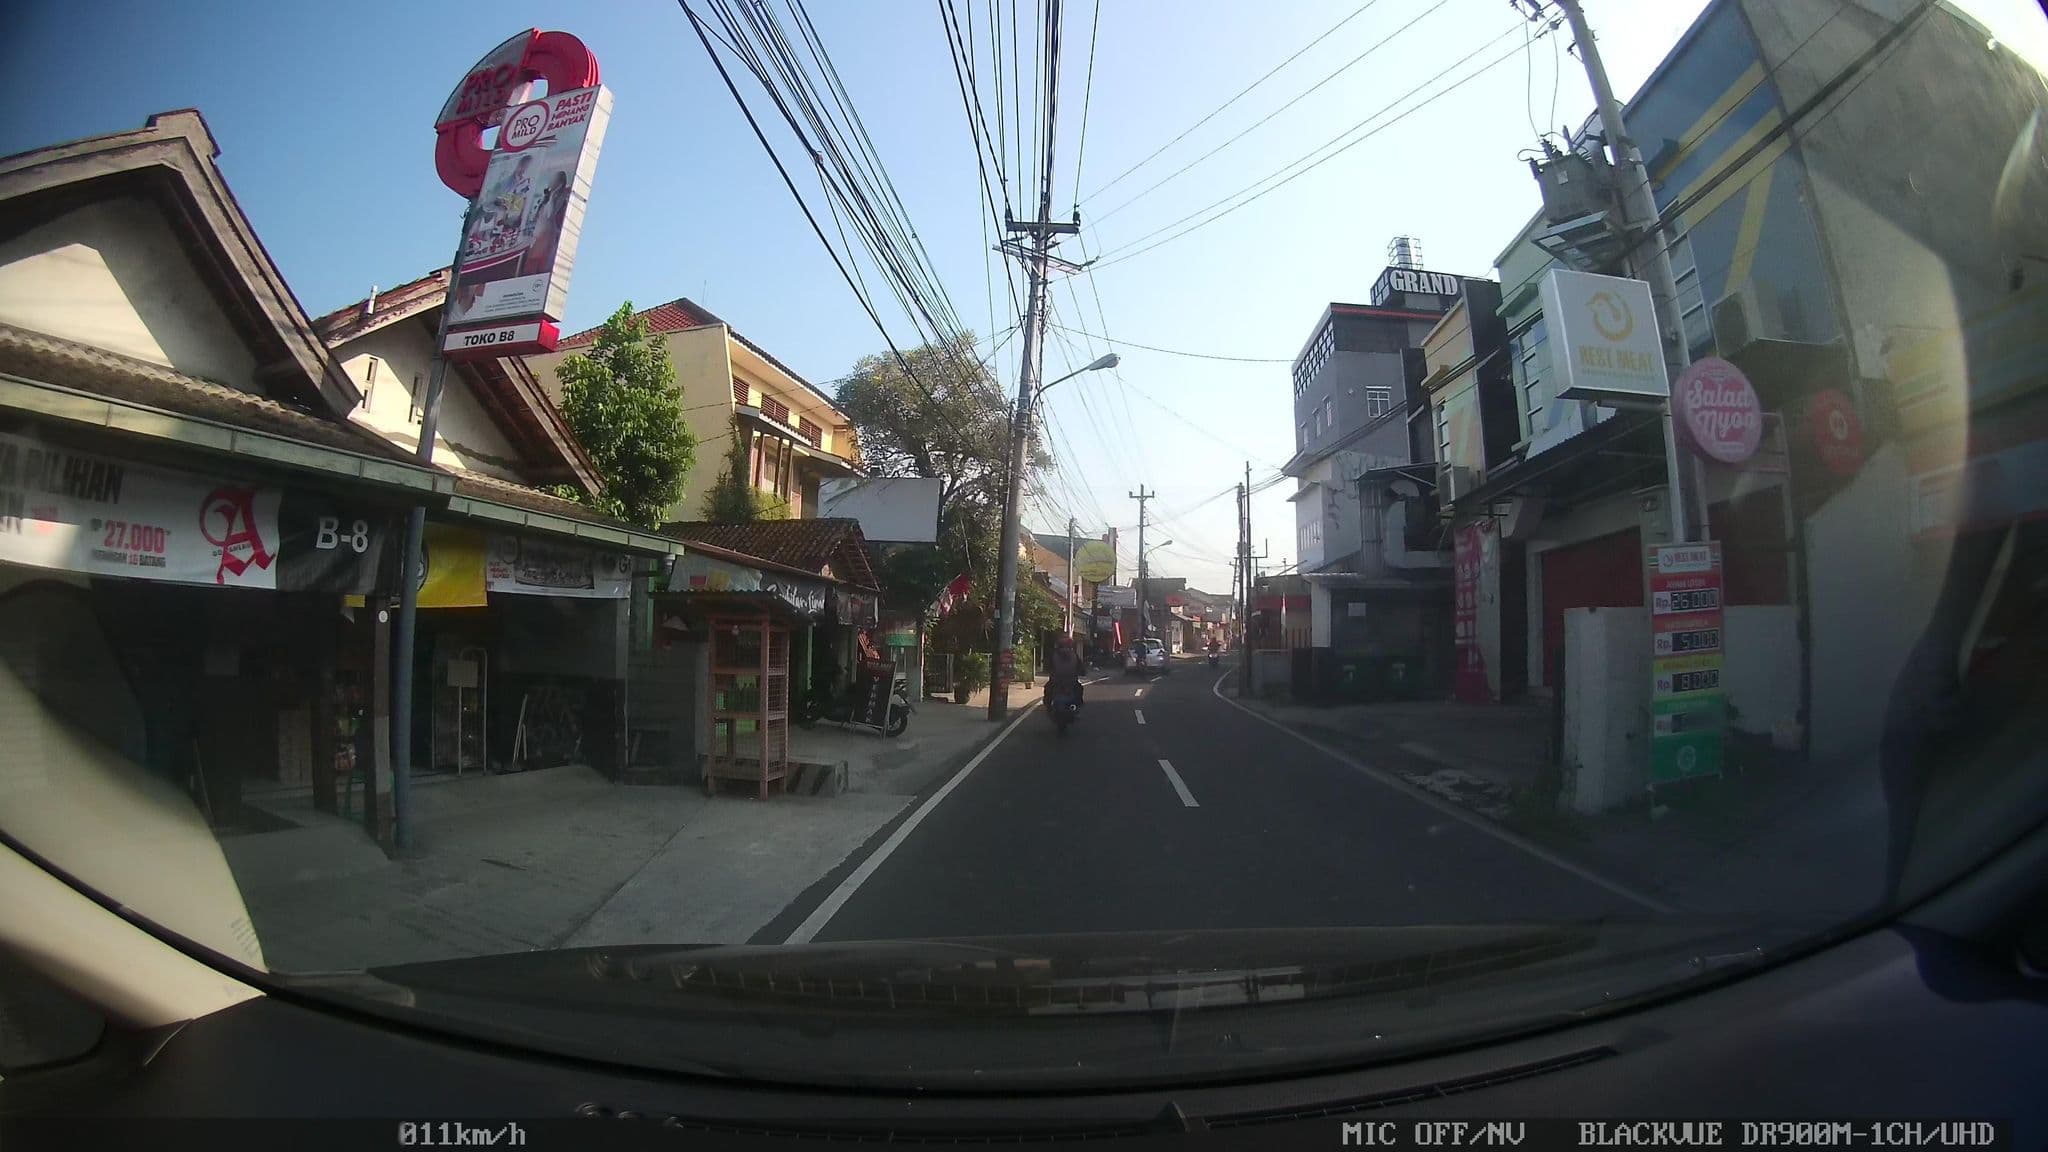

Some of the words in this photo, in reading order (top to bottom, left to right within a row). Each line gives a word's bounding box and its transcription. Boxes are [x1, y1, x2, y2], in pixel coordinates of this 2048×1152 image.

[555, 92, 594, 111] PASTI
[511, 127, 536, 140] MILD
[515, 114, 540, 131] PRO
[1389, 269, 1458, 296] GRAND
[464, 332, 496, 346] TOKO
[499, 330, 515, 342] B8
[1687, 379, 1753, 409] Salad
[103, 519, 165, 554] 27.000
[315, 516, 369, 553] B-8
